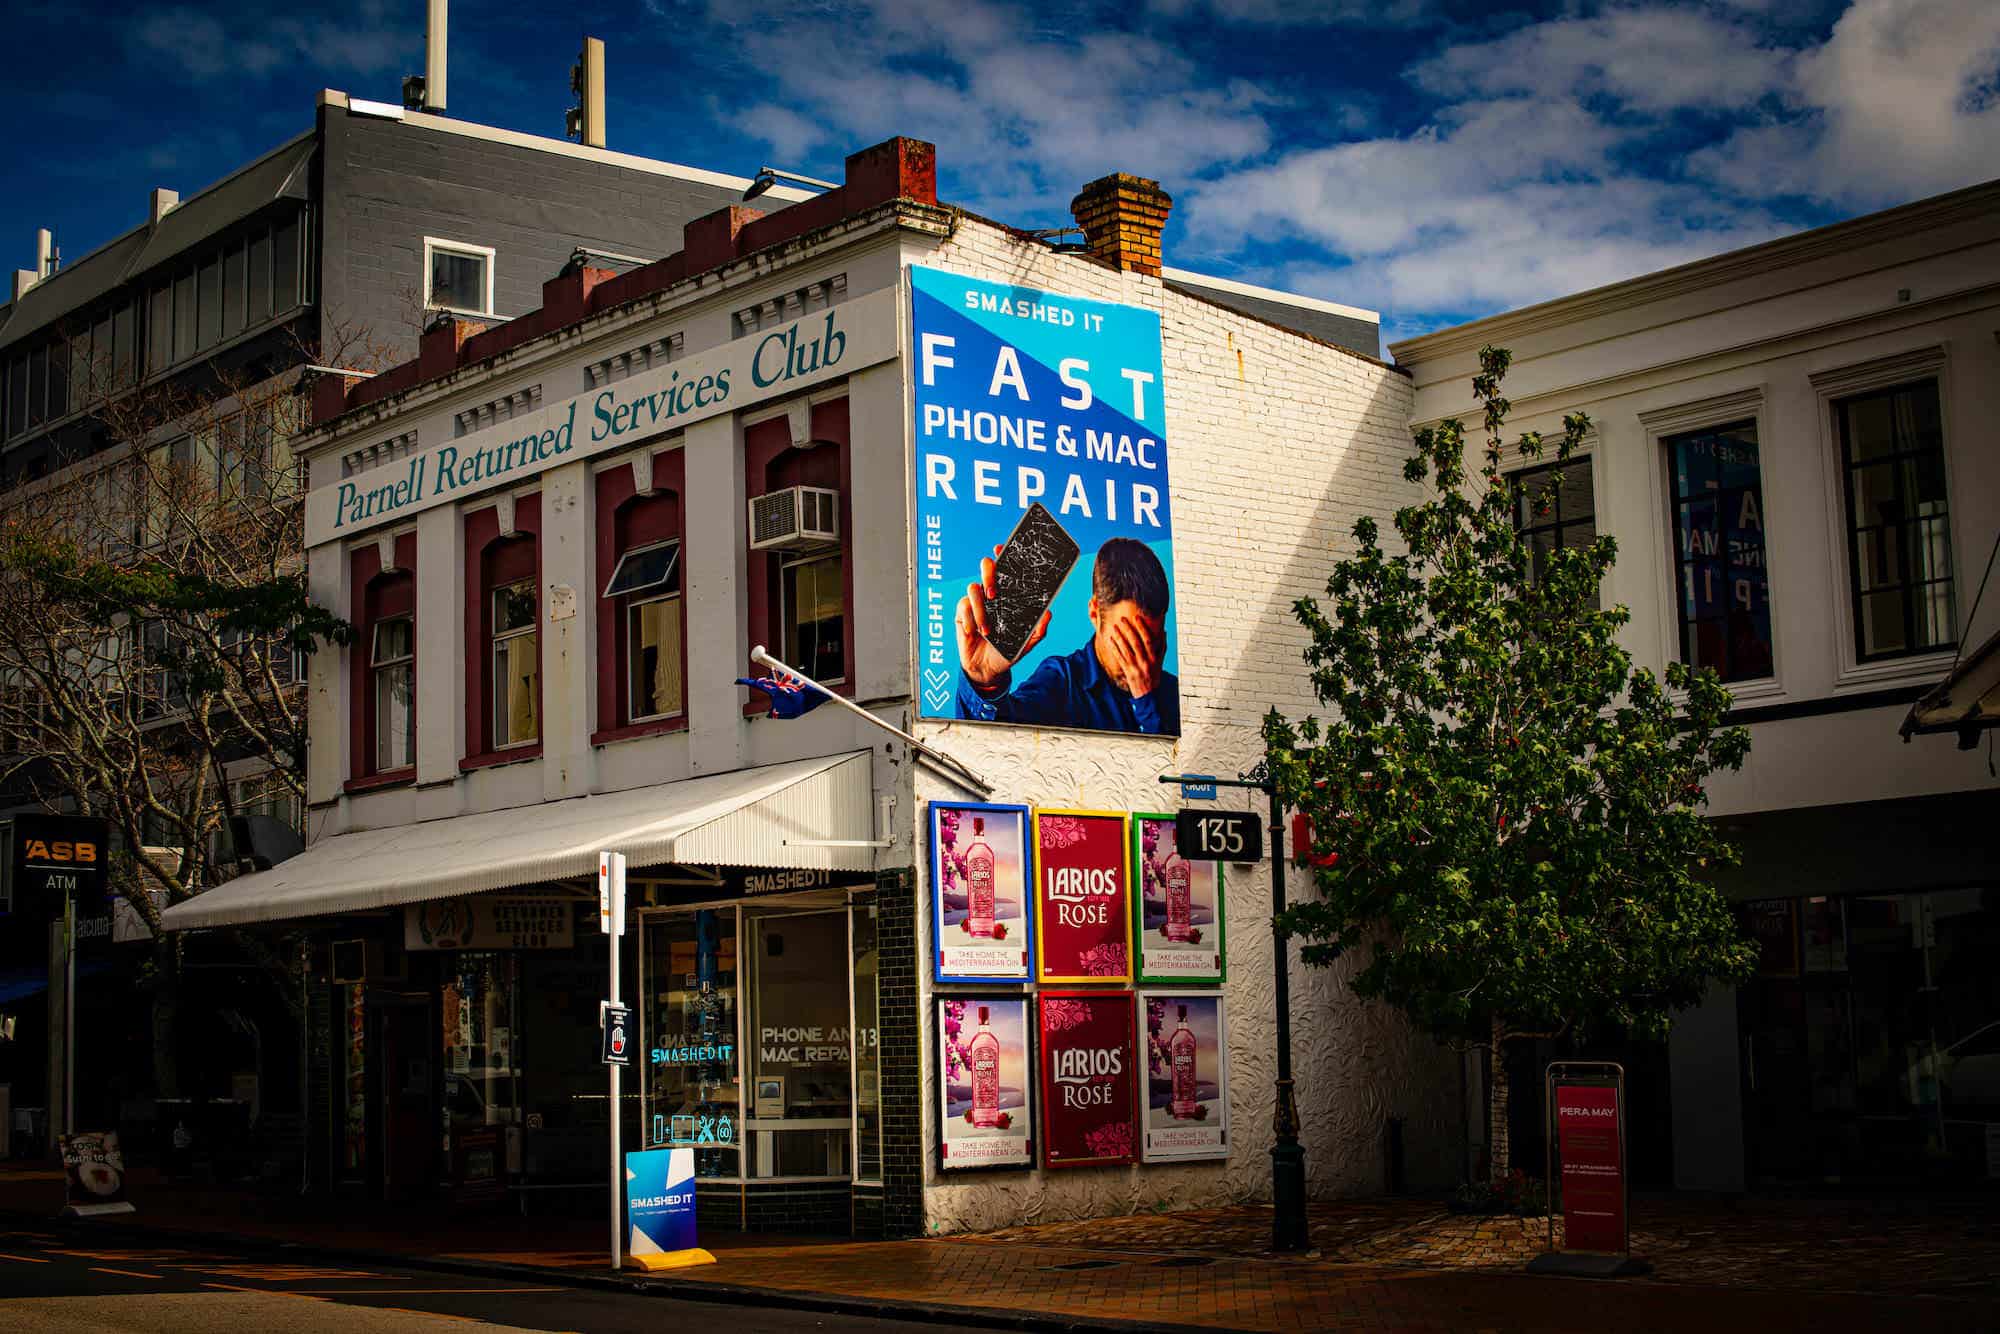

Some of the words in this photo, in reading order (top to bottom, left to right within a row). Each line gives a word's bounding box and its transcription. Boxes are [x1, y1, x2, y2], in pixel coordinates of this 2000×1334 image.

[965, 291, 1075, 327] SMASHED
[1084, 313, 1104, 332] IT
[922, 332, 1154, 420] FAST
[334, 455, 426, 528] Parnell
[433, 400, 576, 495] Returned
[591, 368, 731, 441] Services
[752, 310, 846, 388] Club
[924, 404, 1047, 452] PHONE
[1056, 424, 1078, 457] &
[1086, 429, 1157, 470] MAC
[925, 453, 1161, 528] REPAIR
[926, 514, 942, 580] HERE
[928, 588, 943, 664] RIGHT
[1197, 817, 1244, 853] 135
[25, 840, 97, 863] ASB
[46, 875, 76, 889] ATM
[745, 870, 816, 894] SMASHED
[1047, 867, 1117, 903] LARIOS
[1058, 902, 1108, 928] ROSÉ
[761, 1026, 823, 1043] PHONE
[828, 1026, 851, 1043] AN
[651, 1046, 715, 1064] SMASHED
[717, 1044, 734, 1061] IT
[761, 1046, 800, 1062] MAC
[805, 1045, 851, 1062] REPA
[1053, 1047, 1123, 1084] LARIOS
[1063, 1083, 1113, 1110] ROSÉ
[1560, 1106, 1590, 1117] PERA
[1592, 1107, 1615, 1117] MAY
[631, 1195, 682, 1208] SMASHED
[683, 1194, 693, 1204] IT
